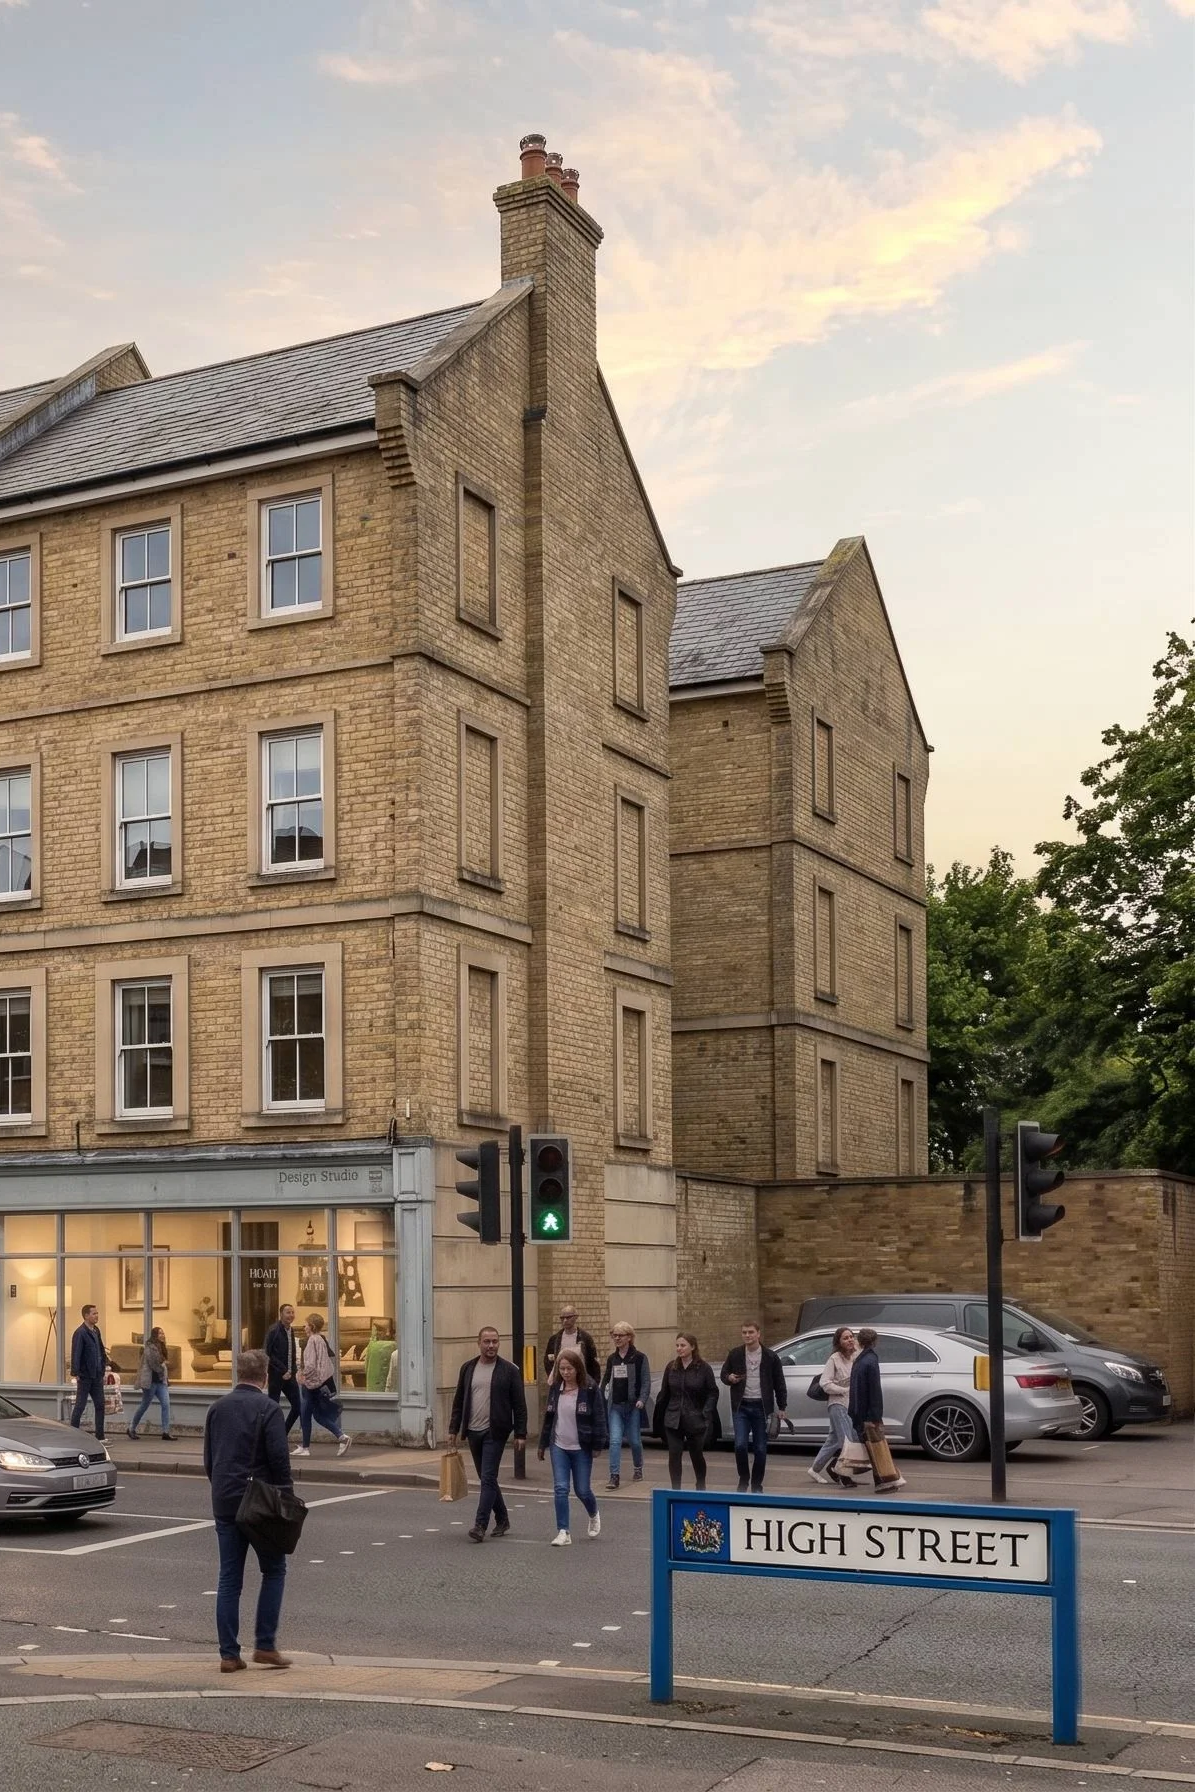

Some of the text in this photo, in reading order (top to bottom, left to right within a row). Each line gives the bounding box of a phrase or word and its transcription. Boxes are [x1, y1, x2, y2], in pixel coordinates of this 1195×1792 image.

[279, 1171, 317, 1186] Design
[320, 1169, 358, 1182] Studio
[744, 1518, 1030, 1568] HIGH STREET
